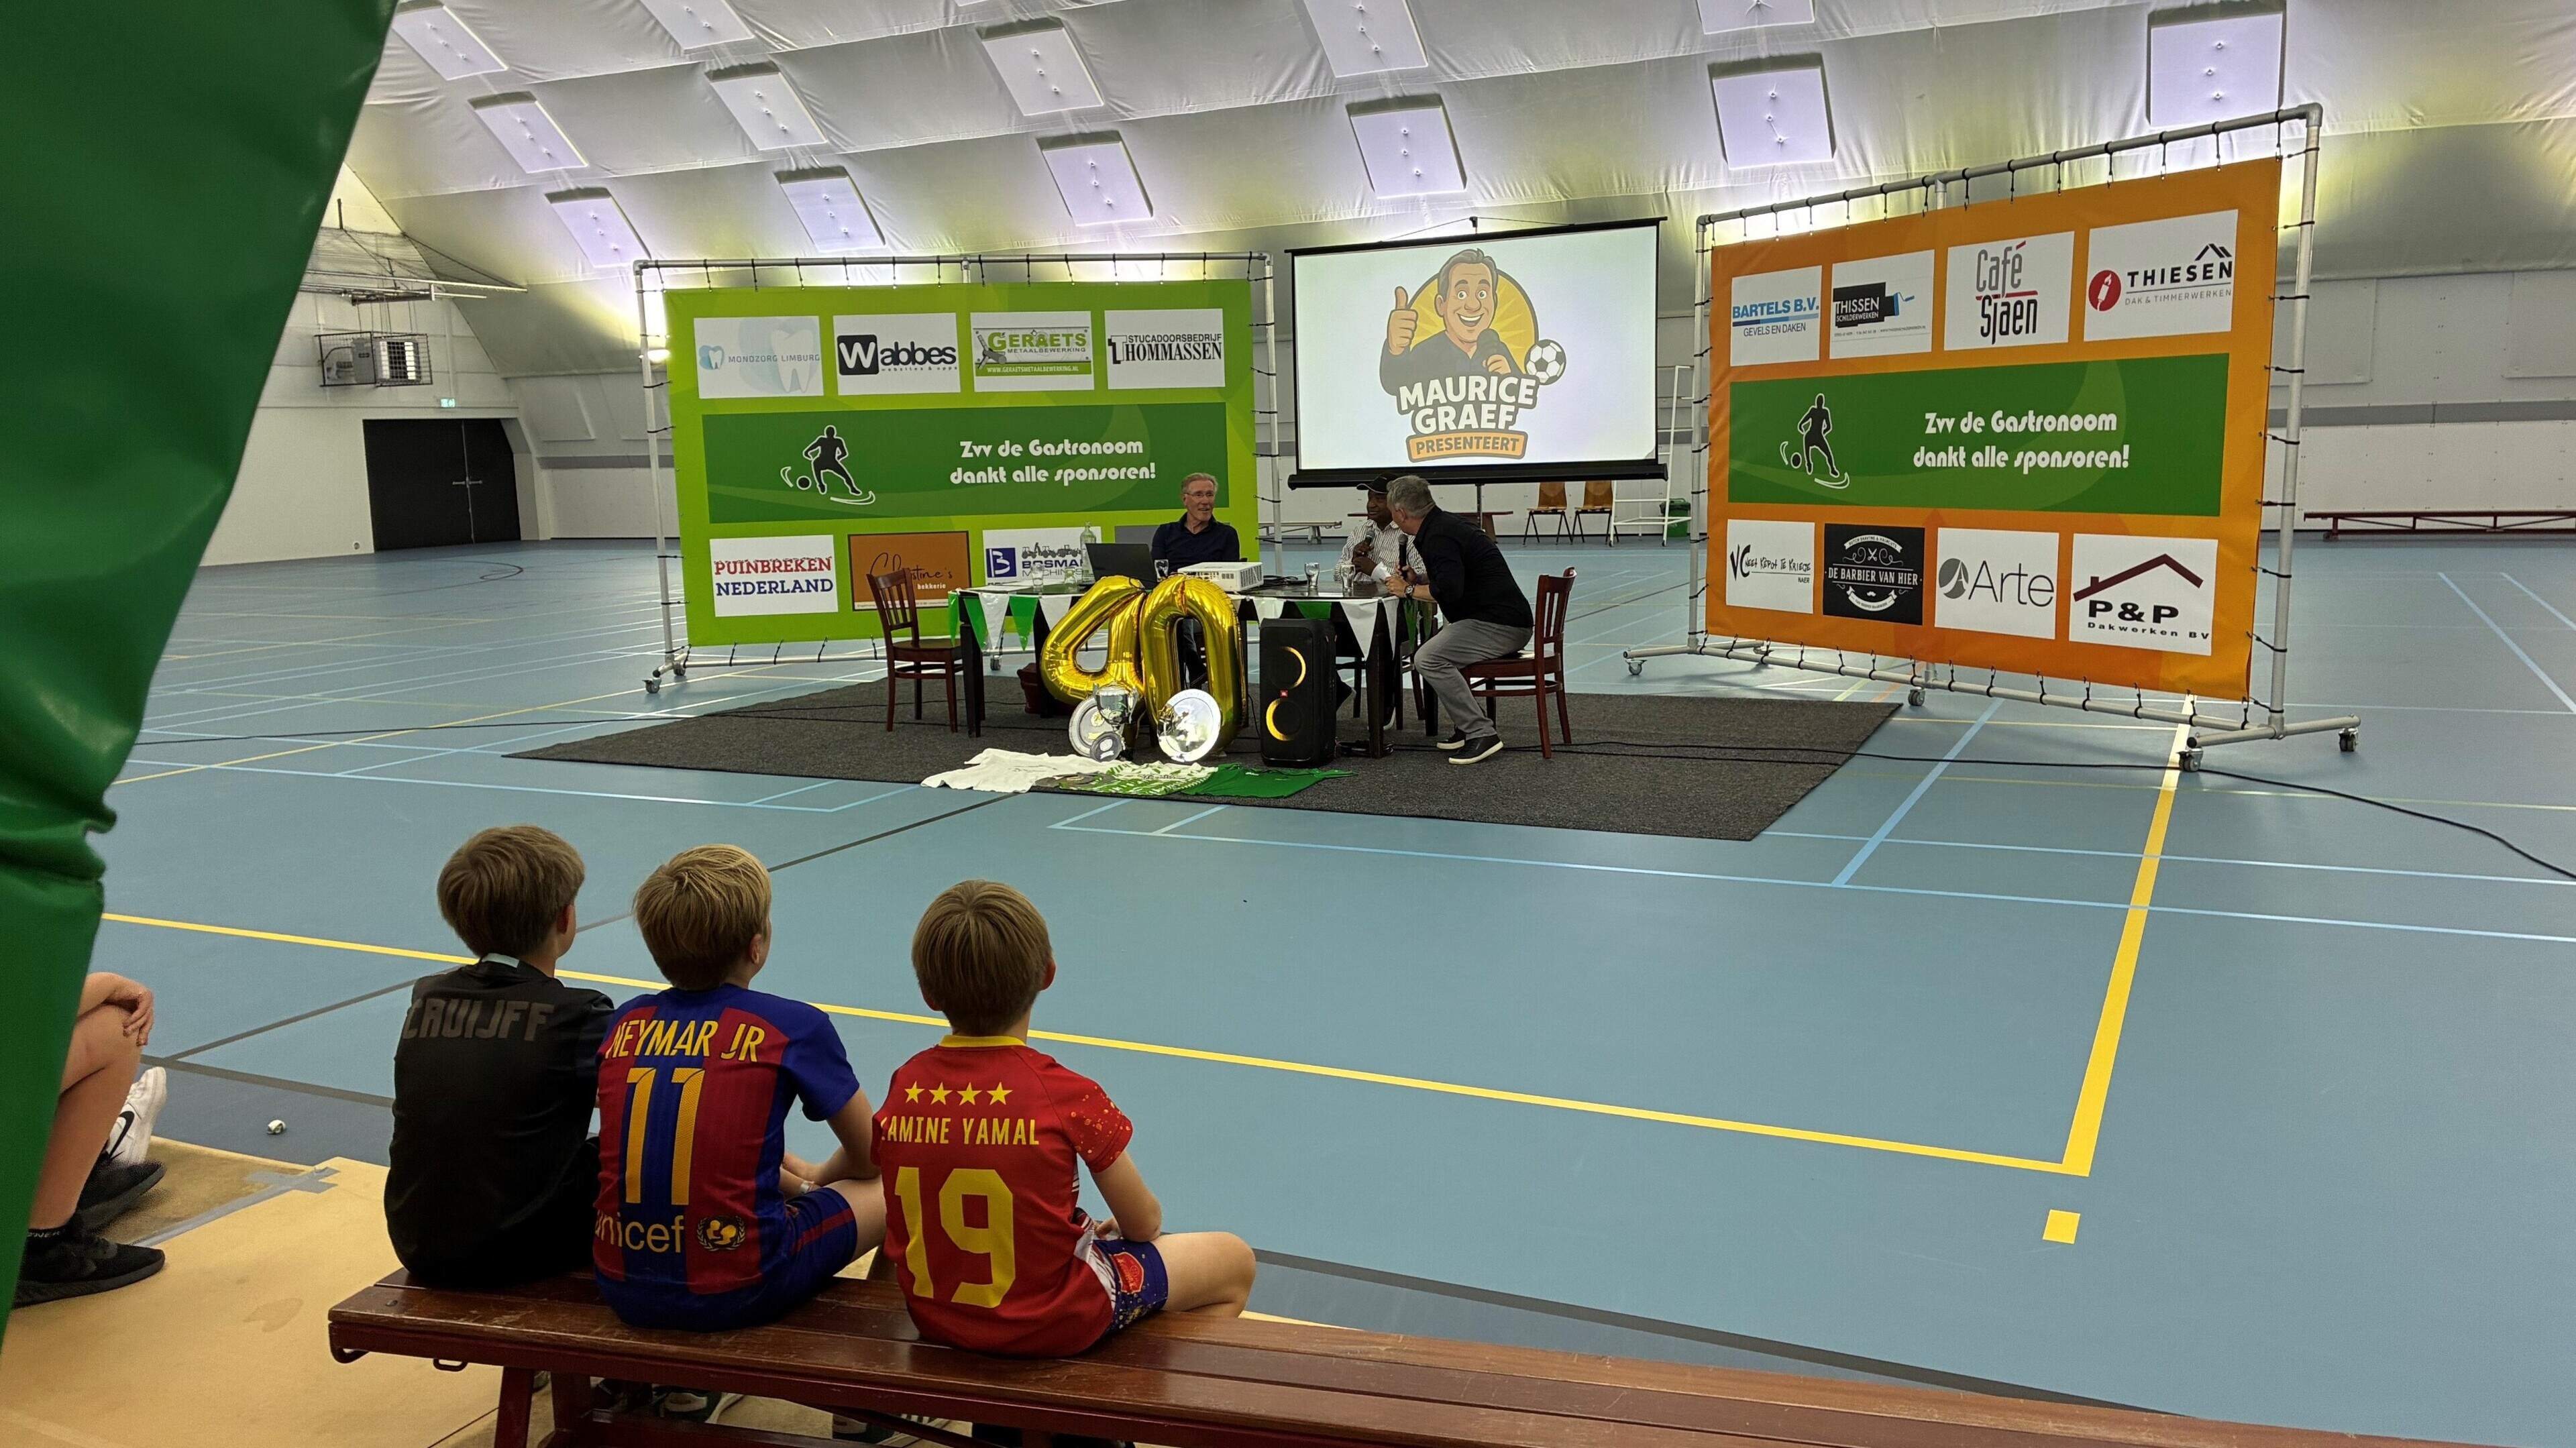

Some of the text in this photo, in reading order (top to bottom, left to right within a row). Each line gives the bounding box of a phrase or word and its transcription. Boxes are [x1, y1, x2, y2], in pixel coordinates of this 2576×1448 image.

[1976, 240, 2027, 299] Café
[2127, 260, 2233, 288] THIESEN
[1732, 296, 1820, 319] BARTELS B.V.
[1835, 296, 1880, 314] THISSEN
[2125, 289, 2233, 306] DAK & TIMMERWERKEN
[1836, 311, 1879, 323] SCHILDERWERKEN
[1980, 294, 2038, 345] Sjaen
[987, 331, 1087, 351] GERAETS
[1128, 334, 1222, 343] STUCADOORSBEDRIJF
[1743, 322, 1807, 337] GEVELS EN DAKEN
[728, 353, 820, 364] MONDZORG LIMBURG
[839, 340, 957, 370] Wabbes
[1399, 375, 1536, 411] MAURICE
[1415, 403, 1515, 435] GRAEF
[1925, 410, 2117, 434] Zvv de Gastronoom
[960, 439, 1143, 458] Zvv de Gastronoom
[1415, 436, 1519, 455] PRESENTEERT
[1913, 444, 2130, 475] dankt alle sponsoren!
[950, 461, 1157, 486] dankt alle sponsoren!
[713, 556, 833, 575] PUINBREKEN
[1022, 559, 1083, 569] BOSMA
[1022, 568, 1083, 577] MCHINS
[1730, 543, 1751, 581] VC
[715, 578, 834, 596] NEDERLAND
[1828, 567, 1918, 586] DE BARBIER VAN HIER
[1968, 560, 2055, 608] Arte
[2088, 599, 2180, 624] P&P
[2088, 622, 2210, 641] Dakwerken BV
[605, 1019, 765, 1063] NEYMAR JR
[627, 1067, 706, 1206] 11
[963, 1117, 1040, 1146] YAMAL
[894, 1166, 1016, 1308] 19
